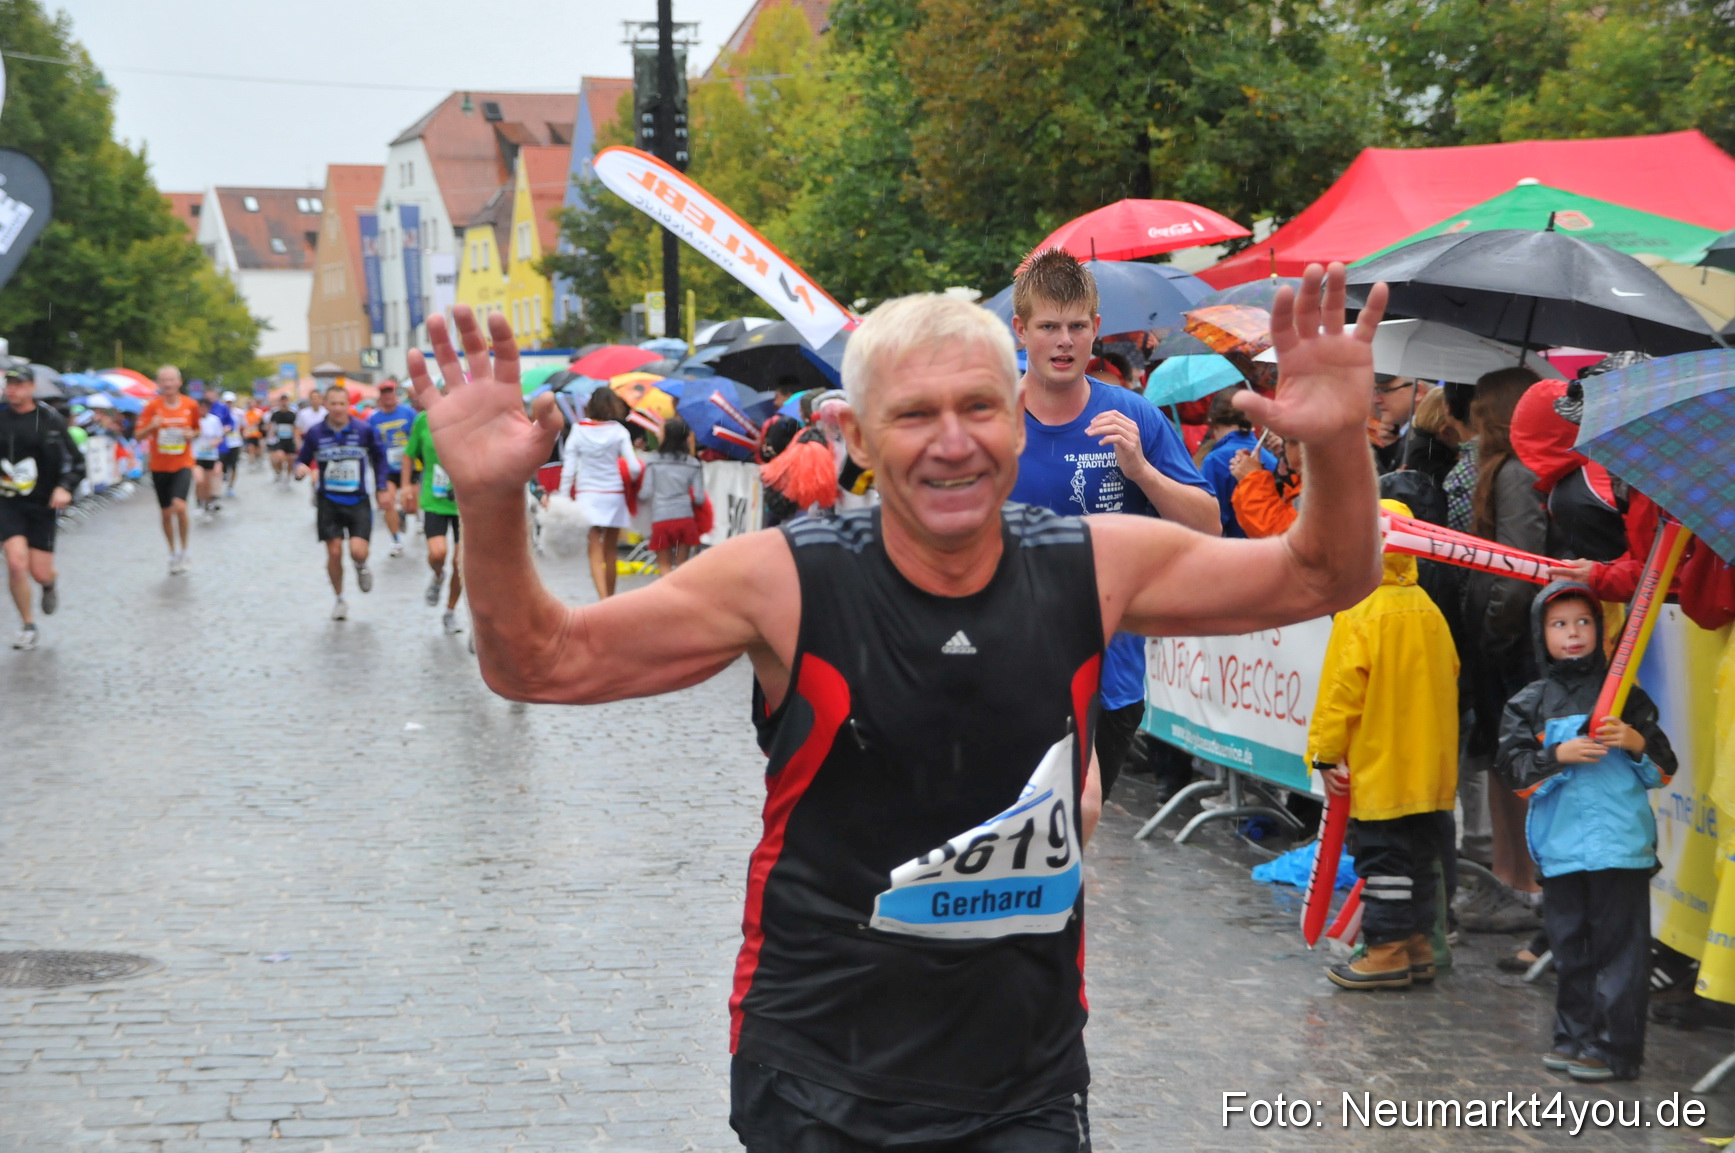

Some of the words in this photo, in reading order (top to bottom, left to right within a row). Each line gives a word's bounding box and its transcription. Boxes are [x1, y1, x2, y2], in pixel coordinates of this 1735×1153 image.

[1148, 222, 1193, 238] Coca-Cola
[1064, 454, 1077, 462] 12.
[1076, 460, 1120, 469] STADTLAU
[1609, 569, 1660, 677] DEUTSCHLAND
[941, 645, 977, 655] adidas
[931, 885, 1043, 918] Gerhard
